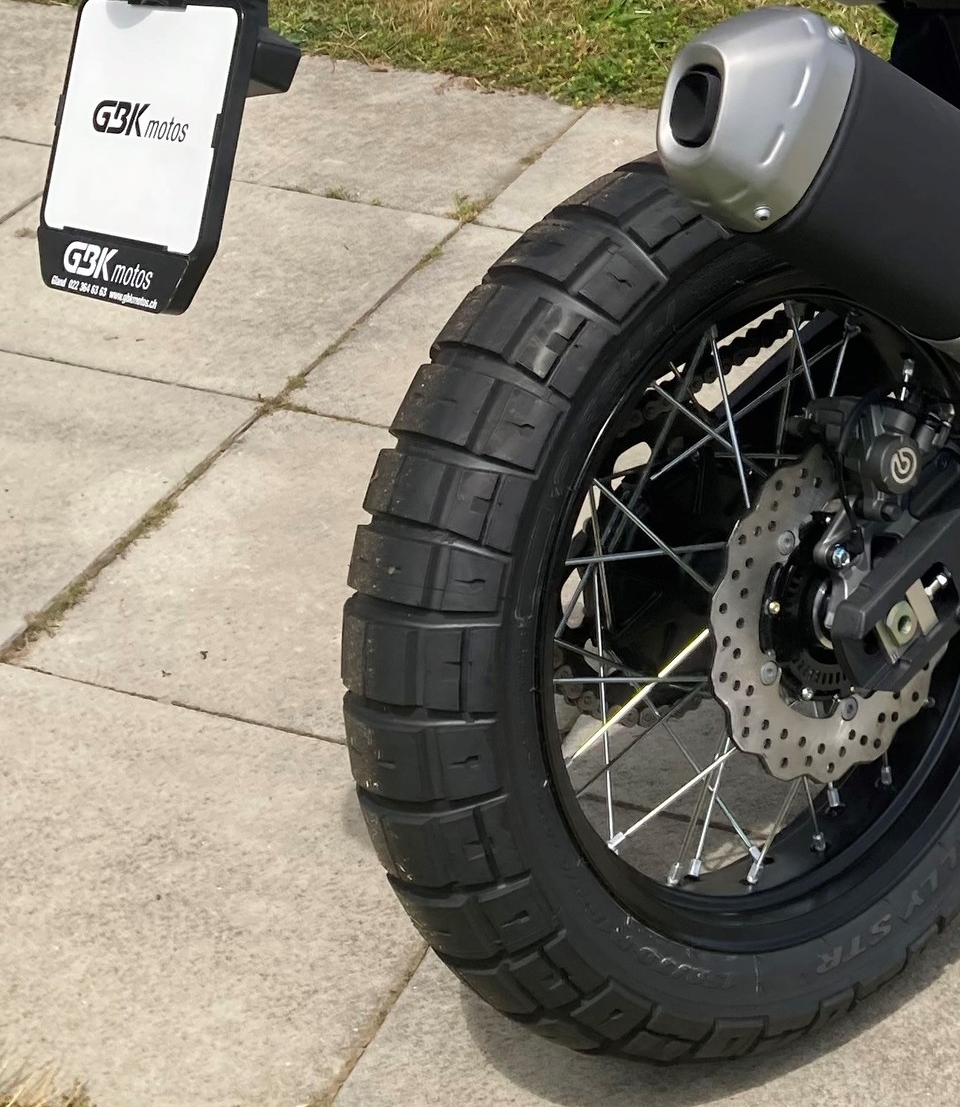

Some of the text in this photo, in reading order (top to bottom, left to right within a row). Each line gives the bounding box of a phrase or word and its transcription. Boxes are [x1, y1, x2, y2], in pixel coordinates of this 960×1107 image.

[92, 99, 189, 143] GBK motos
[63, 240, 154, 291] GBK motos
[68, 278, 80, 292] 022
[816, 913, 892, 975] STR
